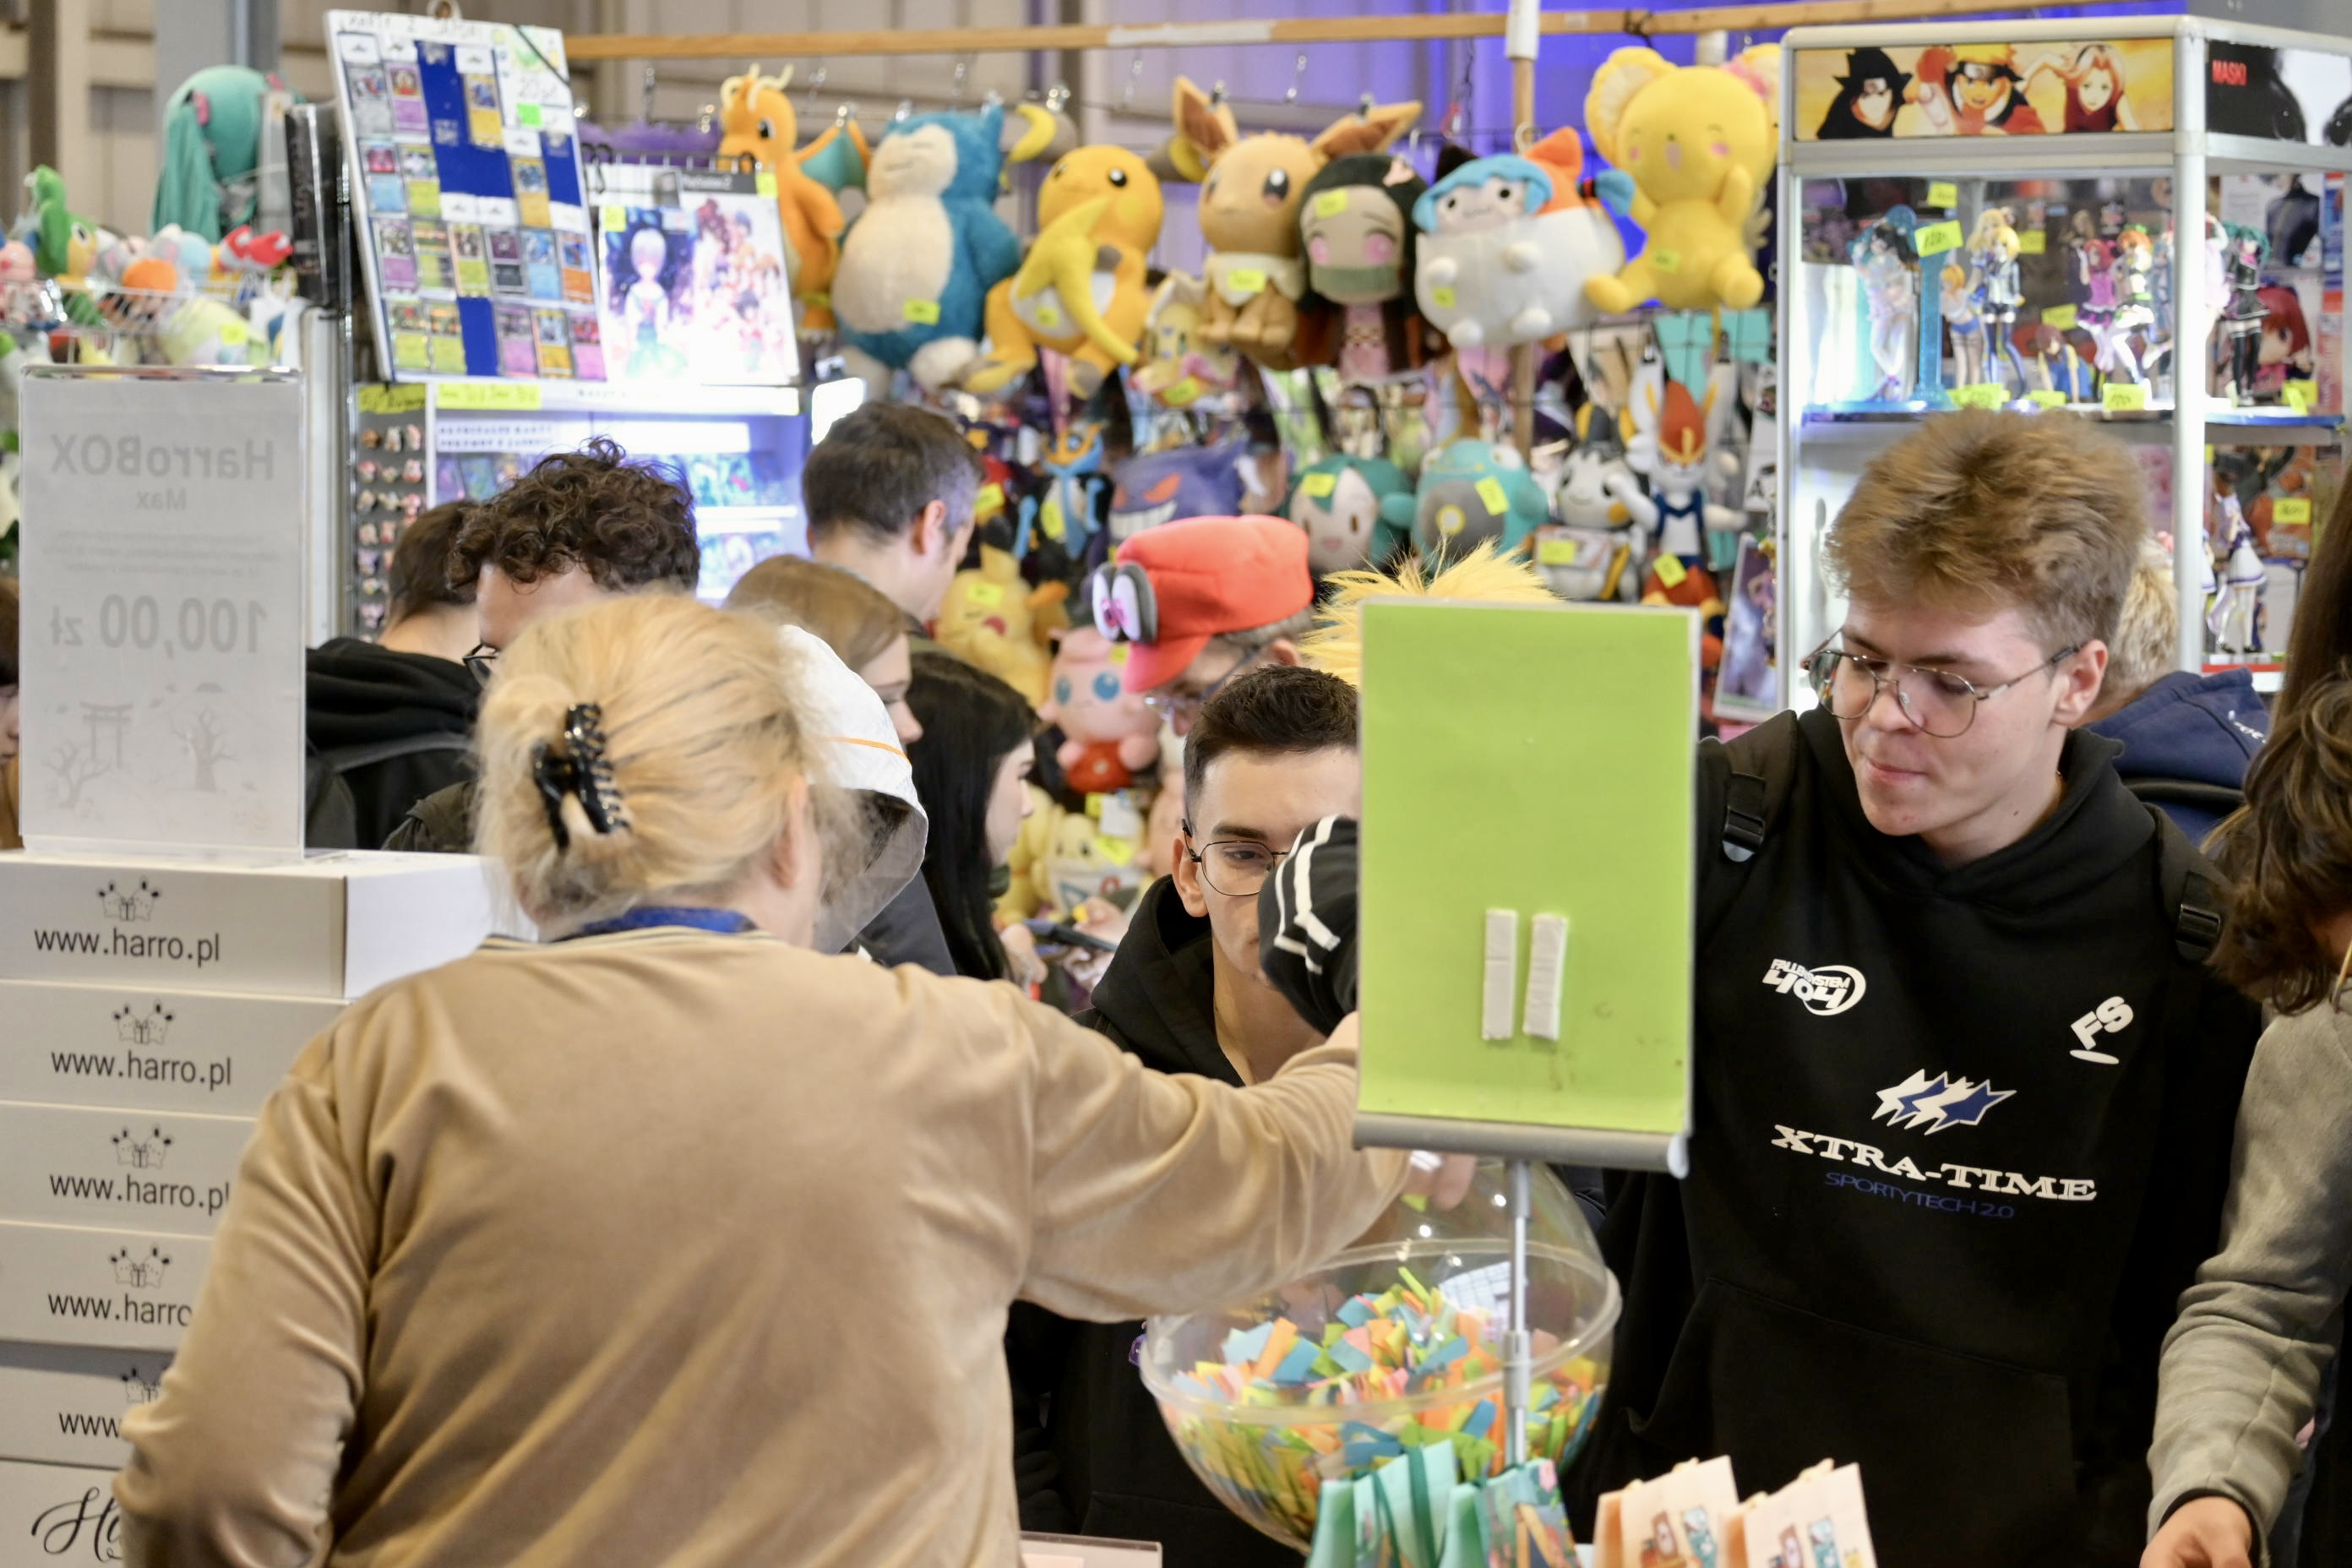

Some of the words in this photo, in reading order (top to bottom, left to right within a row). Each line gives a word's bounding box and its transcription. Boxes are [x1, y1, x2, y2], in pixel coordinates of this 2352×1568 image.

[35, 928, 220, 967] www.harro.pl
[2070, 996, 2134, 1051] FS
[52, 1050, 231, 1092] www.harro.pl
[1771, 1124, 2098, 1200] XTRA-TIME
[1825, 1172, 1976, 1214] SPORTYTECH
